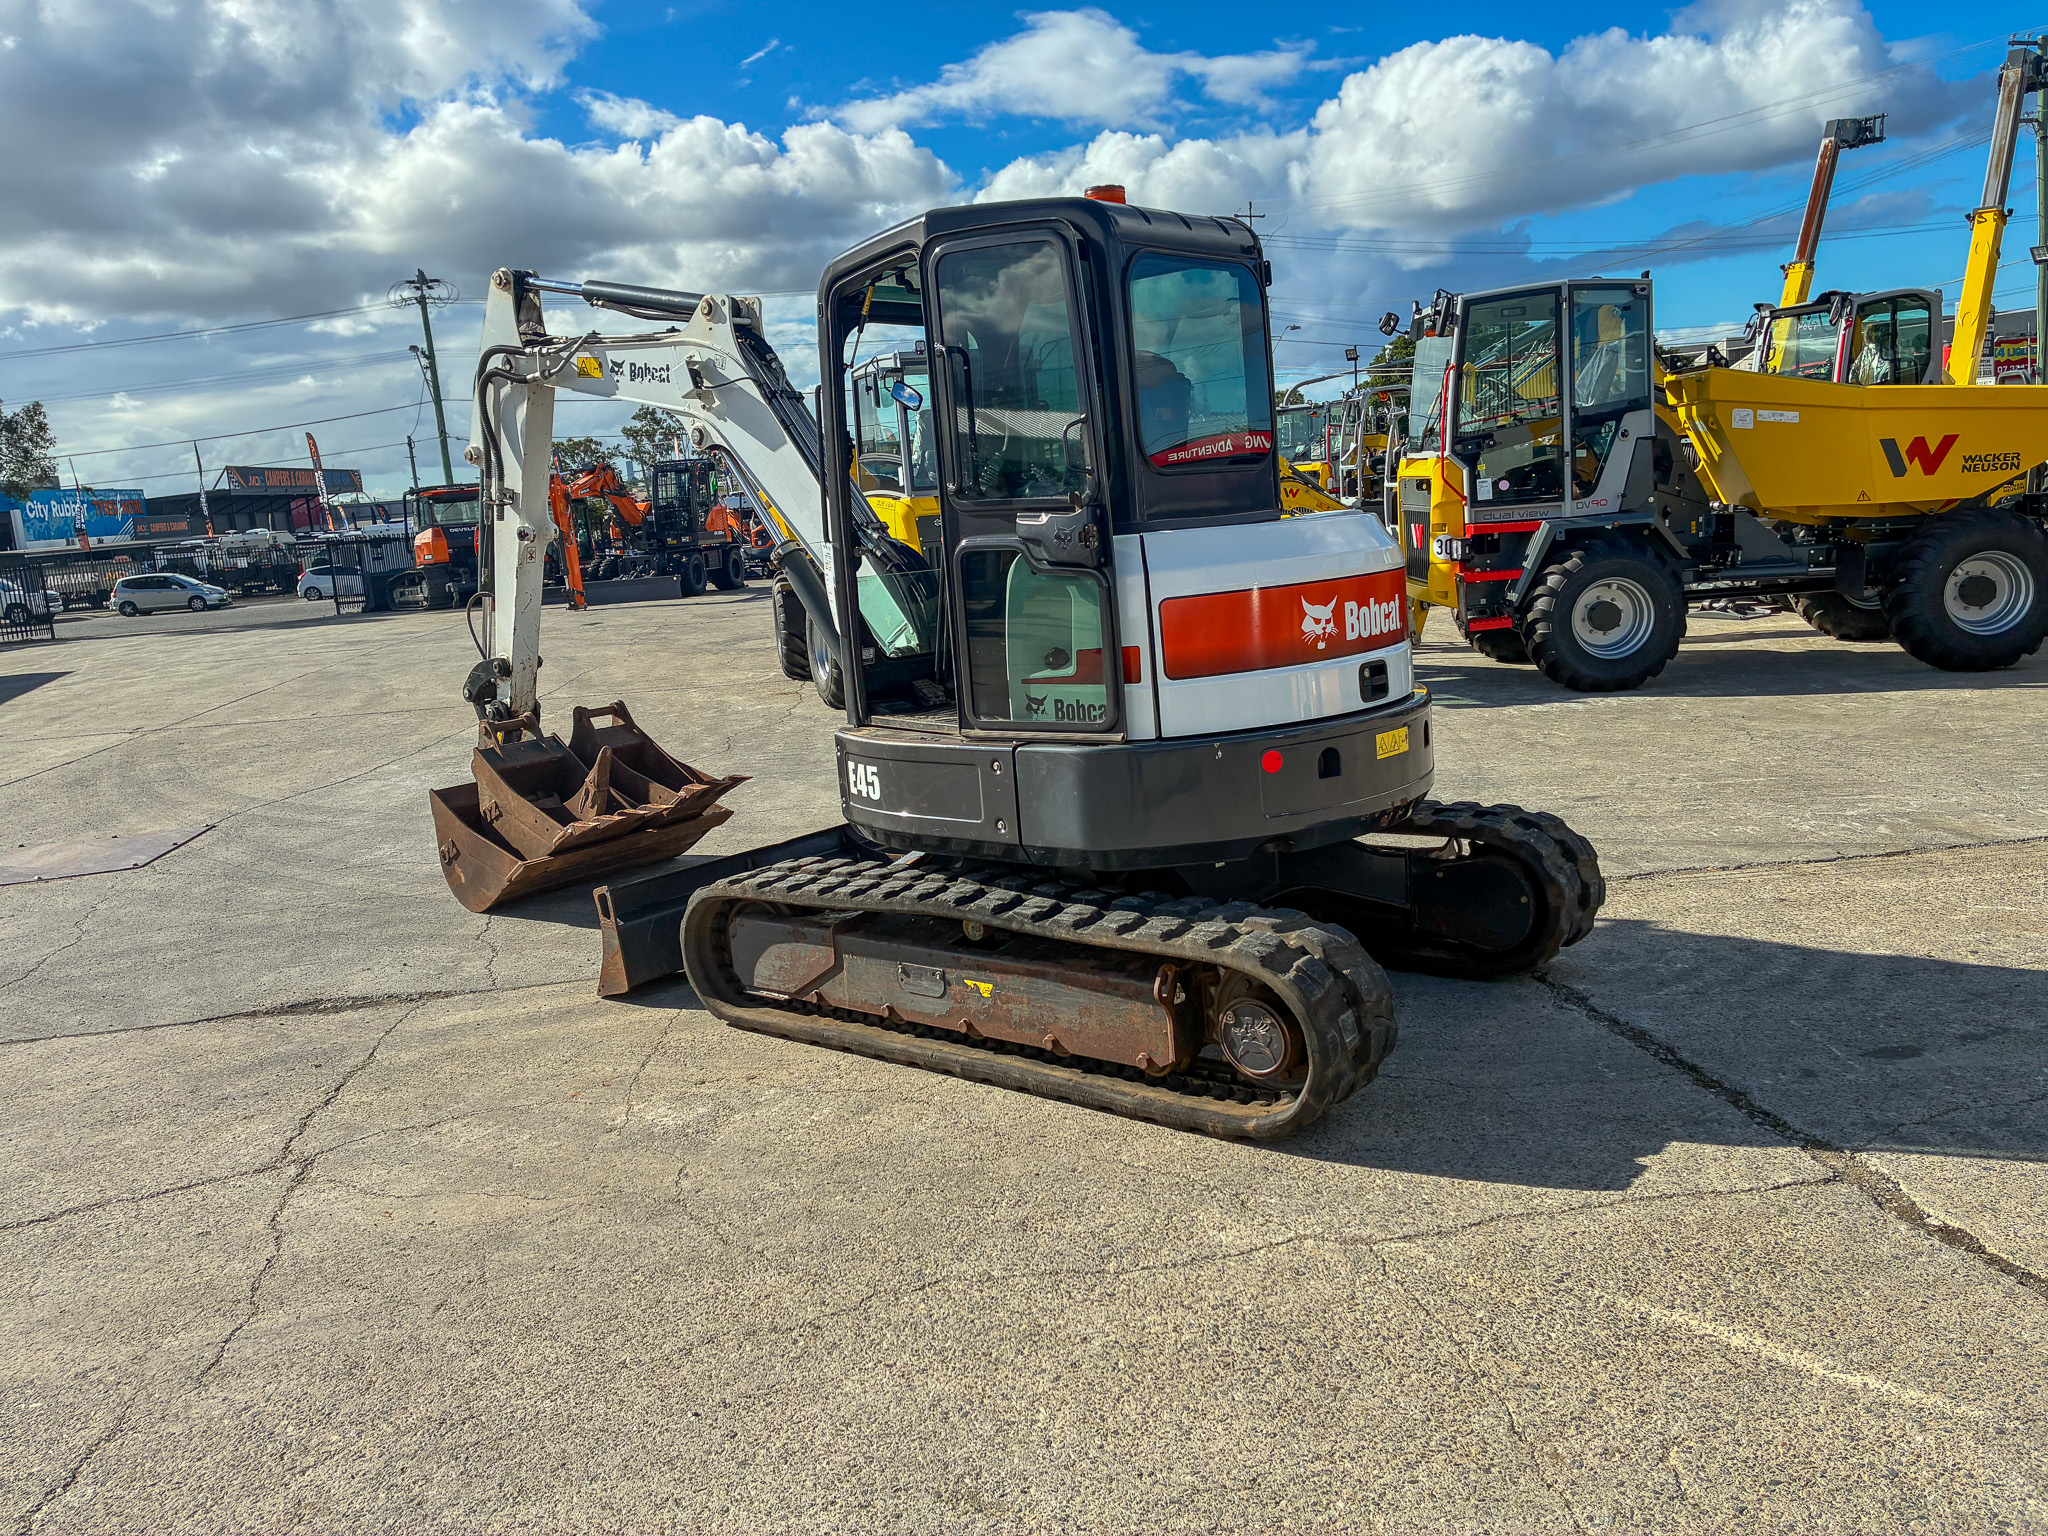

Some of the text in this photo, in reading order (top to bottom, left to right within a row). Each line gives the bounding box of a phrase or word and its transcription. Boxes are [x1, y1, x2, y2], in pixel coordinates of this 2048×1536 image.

[629, 362, 671, 384] Bobcat
[1962, 452, 2021, 464] WACKER
[1961, 462, 2020, 473] NEUSON
[26, 500, 88, 521] City Rubbr
[91, 500, 118, 516] TYRES
[121, 500, 145, 514] MORE
[1576, 499, 1609, 510] DV90
[1483, 510, 1550, 520] dual view
[1436, 538, 1452, 555] 30
[1344, 594, 1401, 641] Bobcat
[847, 760, 881, 801] E45
